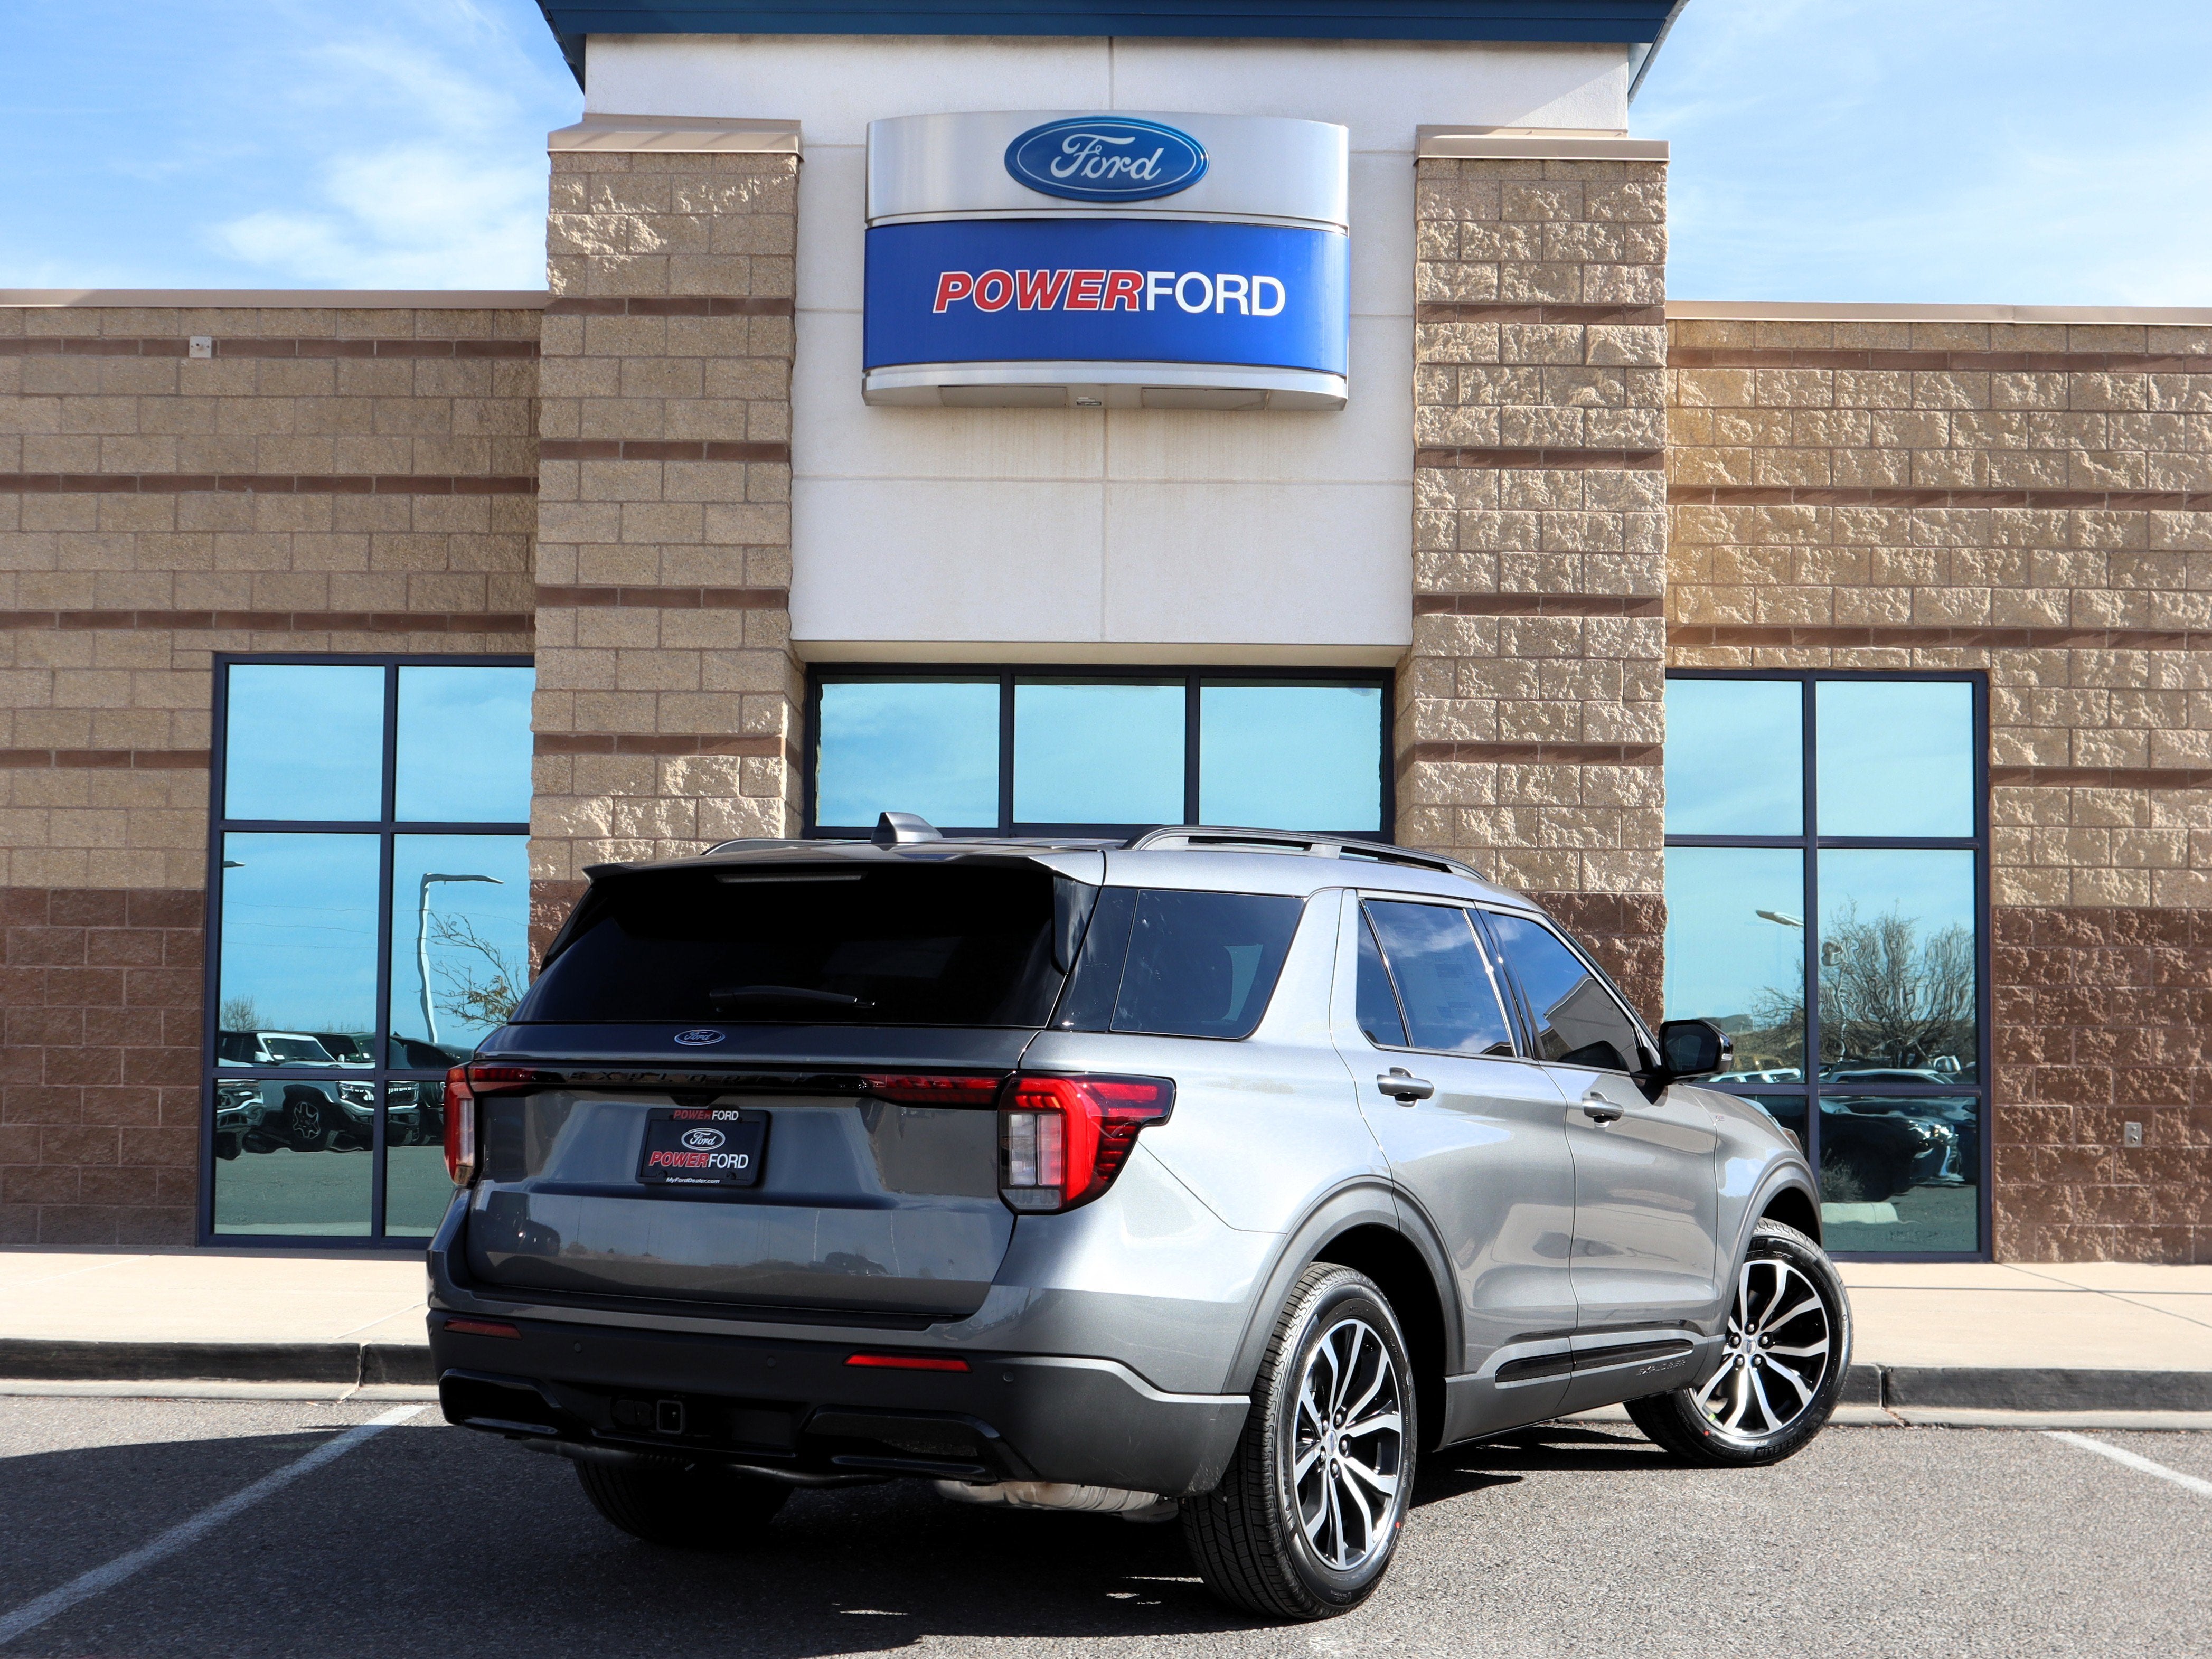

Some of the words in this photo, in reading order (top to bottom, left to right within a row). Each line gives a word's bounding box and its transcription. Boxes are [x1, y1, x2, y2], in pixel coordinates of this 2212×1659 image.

[1050, 134, 1165, 181] Ford
[933, 269, 1286, 316] POWERFORD
[684, 1031, 714, 1040] Ford
[673, 1110, 739, 1121] POWERFORD
[690, 1132, 717, 1146] Ford
[648, 1151, 749, 1169] POWERFORD
[1636, 1359, 1687, 1375] EXPLORER
